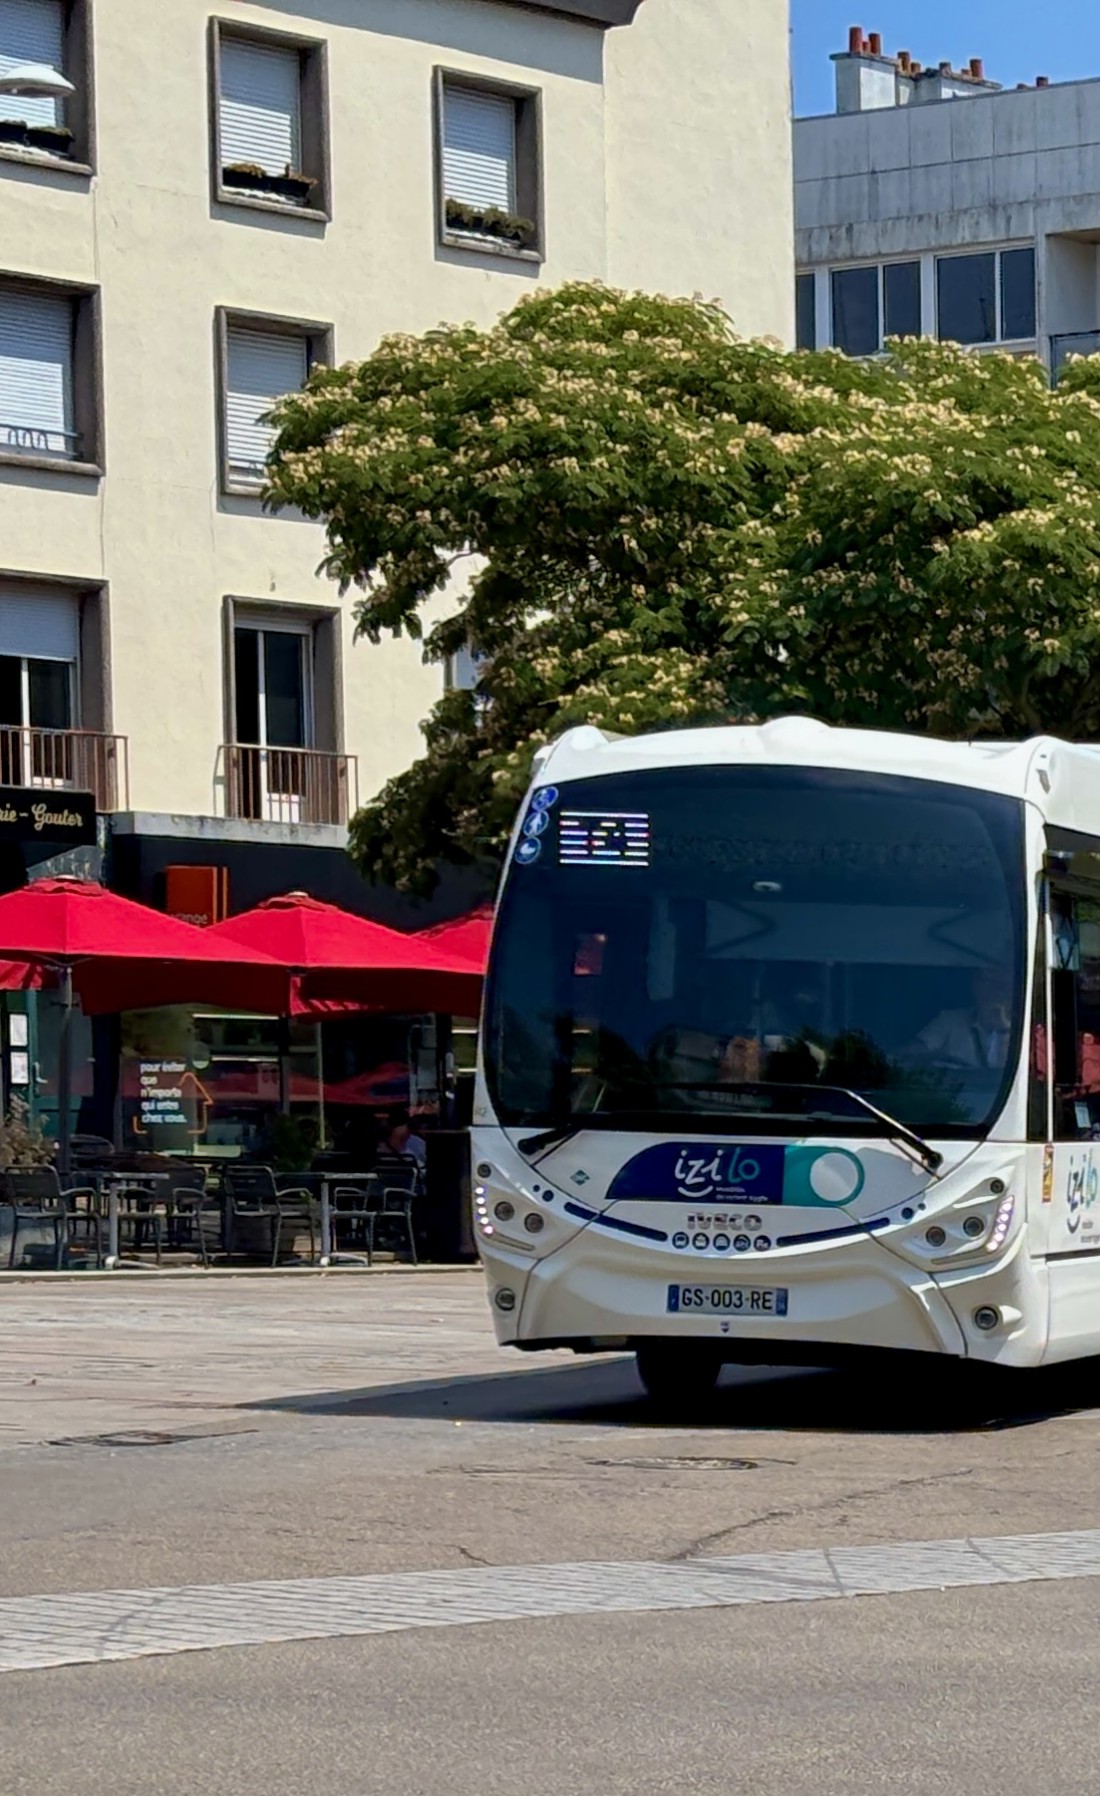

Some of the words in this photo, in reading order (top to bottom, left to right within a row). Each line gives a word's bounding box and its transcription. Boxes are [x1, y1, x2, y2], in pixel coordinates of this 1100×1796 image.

[675, 1147, 761, 1185] izilo
[687, 1212, 763, 1231] IVECO
[681, 1288, 775, 1310] GS-003-RE
